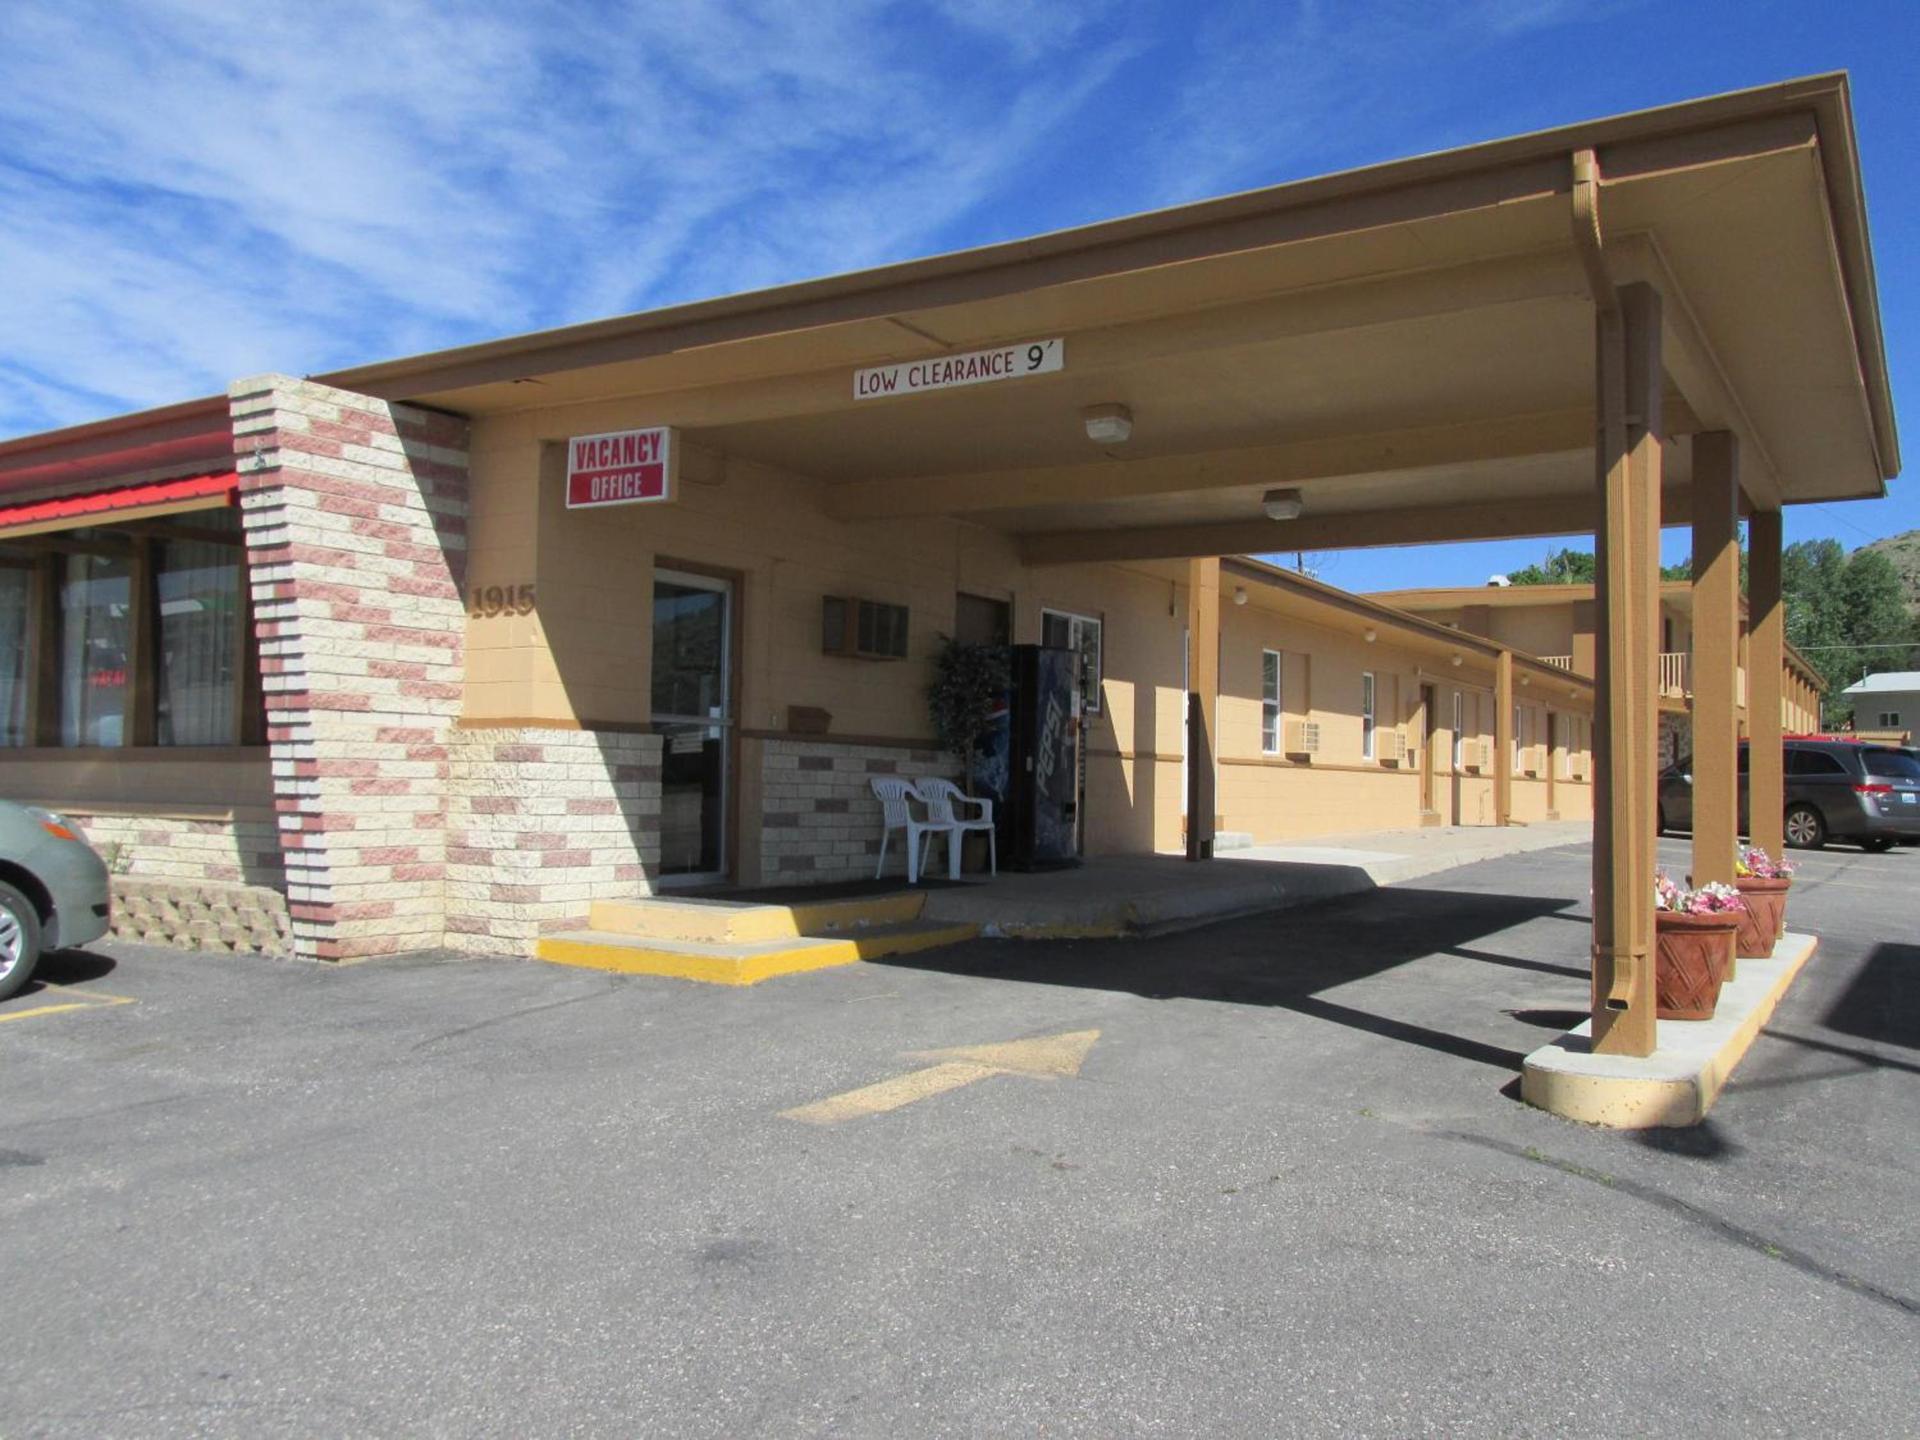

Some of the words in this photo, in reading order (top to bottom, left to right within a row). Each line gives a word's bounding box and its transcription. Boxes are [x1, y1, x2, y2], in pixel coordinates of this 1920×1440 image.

[859, 369, 898, 395] LOW
[908, 351, 1014, 388] CLEARANCE
[575, 432, 661, 470] VACANCY
[591, 472, 643, 500] OFFICE
[472, 584, 536, 619] 1915
[1036, 690, 1064, 798] PEPSI
